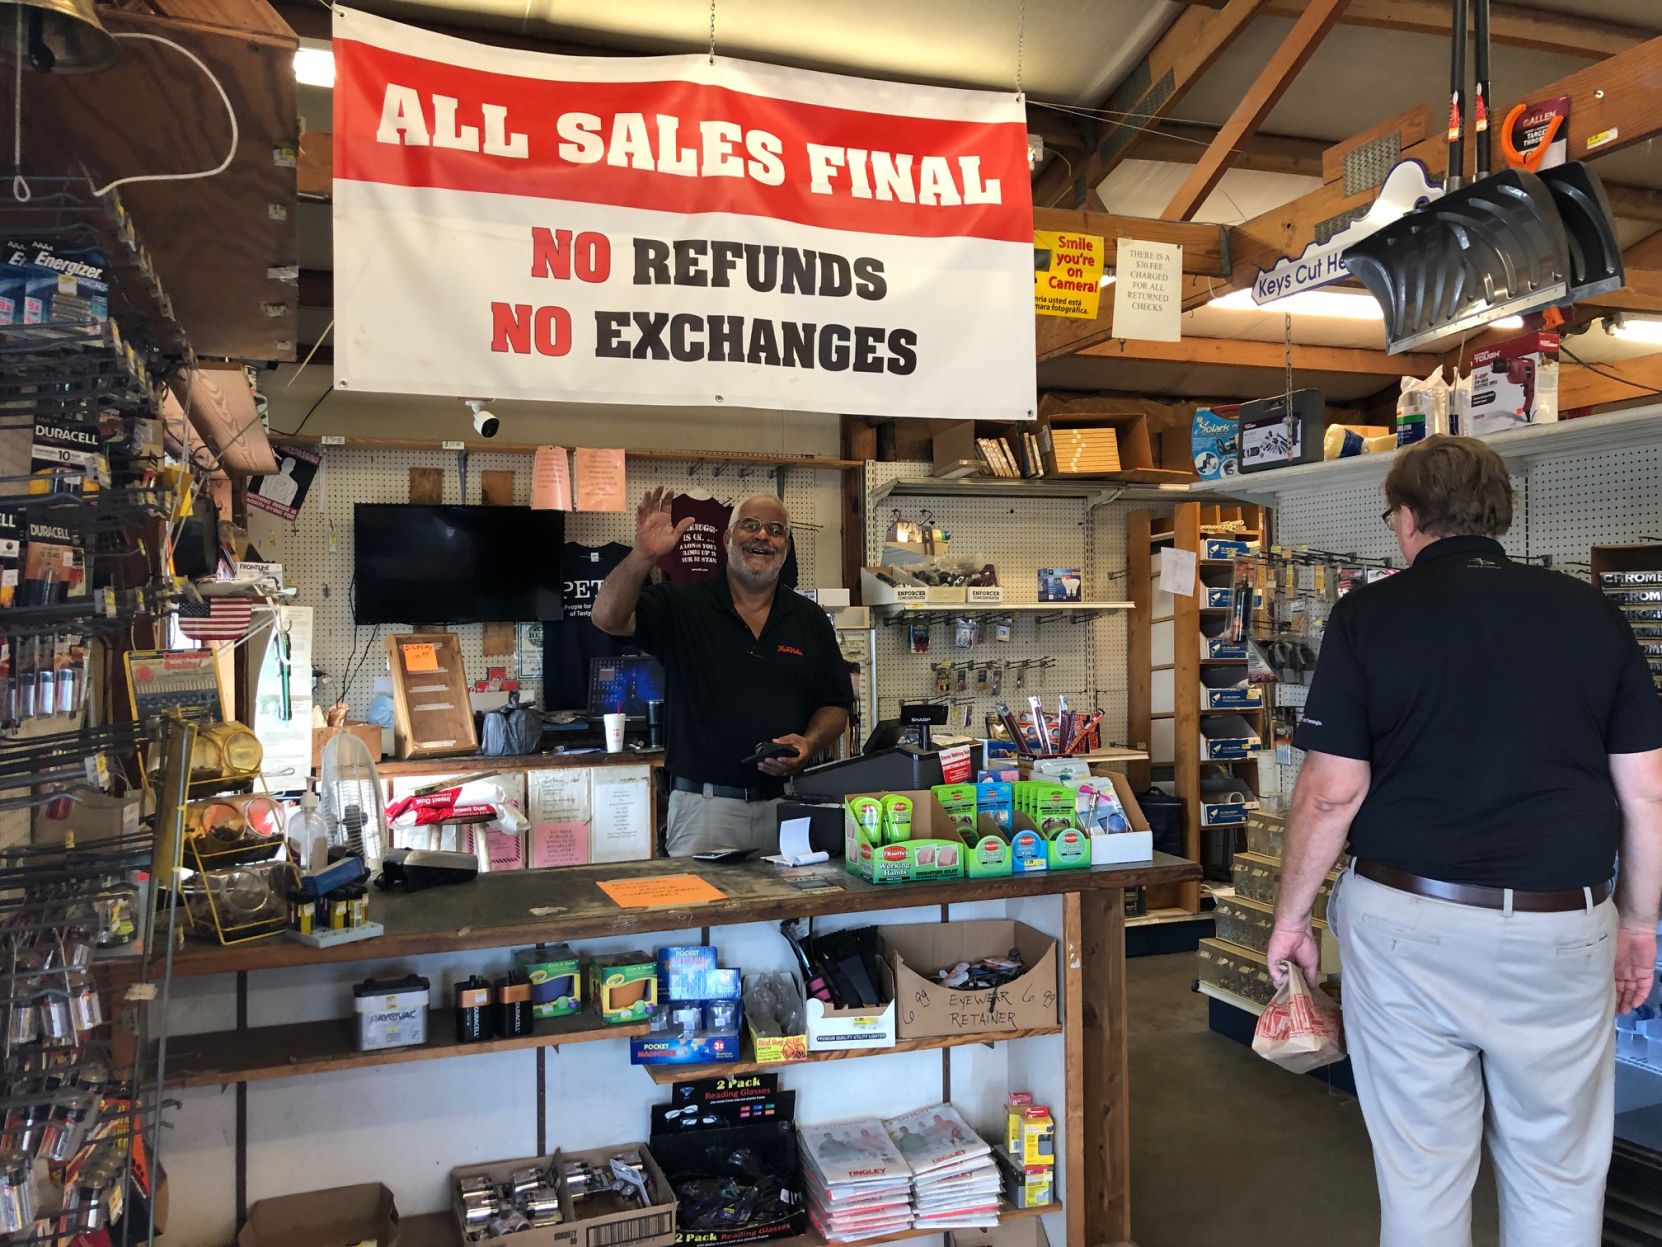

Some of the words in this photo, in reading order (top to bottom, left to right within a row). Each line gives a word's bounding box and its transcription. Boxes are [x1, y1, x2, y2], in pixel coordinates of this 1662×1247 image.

[377, 83, 528, 159] ALL
[557, 111, 785, 187] SALES
[807, 142, 1002, 206] FINAL
[1058, 236, 1093, 251] Smile
[1056, 251, 1095, 266] you're
[1129, 249, 1155, 260] THERE
[1156, 251, 1164, 261] IS
[1165, 253, 1171, 262] A
[34, 251, 103, 278] Energizer
[531, 226, 611, 283] NO
[632, 237, 888, 301] REFUNDS
[1136, 261, 1149, 269] $30
[1150, 262, 1164, 271] FEE
[1067, 267, 1083, 278] on
[1130, 271, 1168, 281] CHARGED
[1259, 273, 1291, 298] Keys
[1296, 258, 1322, 284] Cut
[1048, 275, 1099, 293] Camera!
[1132, 281, 1148, 290] FOR
[1149, 282, 1165, 292] ALL
[1048, 296, 1067, 304] usted
[1127, 291, 1169, 302] RETURNED
[1051, 304, 1090, 314] fotográfica.
[1132, 301, 1164, 312] CHECKS
[491, 302, 572, 356] NO
[595, 310, 918, 376] EXCHANGES
[1474, 351, 1501, 363] TOUGH
[35, 425, 99, 445] DURACELL
[58, 450, 71, 461] 10
[30, 523, 70, 540] DURACELL
[880, 862, 911, 870] Working
[950, 991, 1009, 1008] EYEWEAR
[370, 1009, 417, 1024] RAYOVAC
[950, 1012, 1018, 1030] RETAINER
[716, 1080, 725, 1090] 2
[728, 1077, 761, 1089] Pack
[705, 1090, 739, 1100] Reading
[740, 1086, 772, 1096] Glasses
[848, 1167, 886, 1177] TINGLEY
[675, 1233, 683, 1243] 2
[686, 1232, 717, 1243] Pack
[721, 1227, 757, 1240] Reading
[759, 1222, 791, 1234] Glasses
